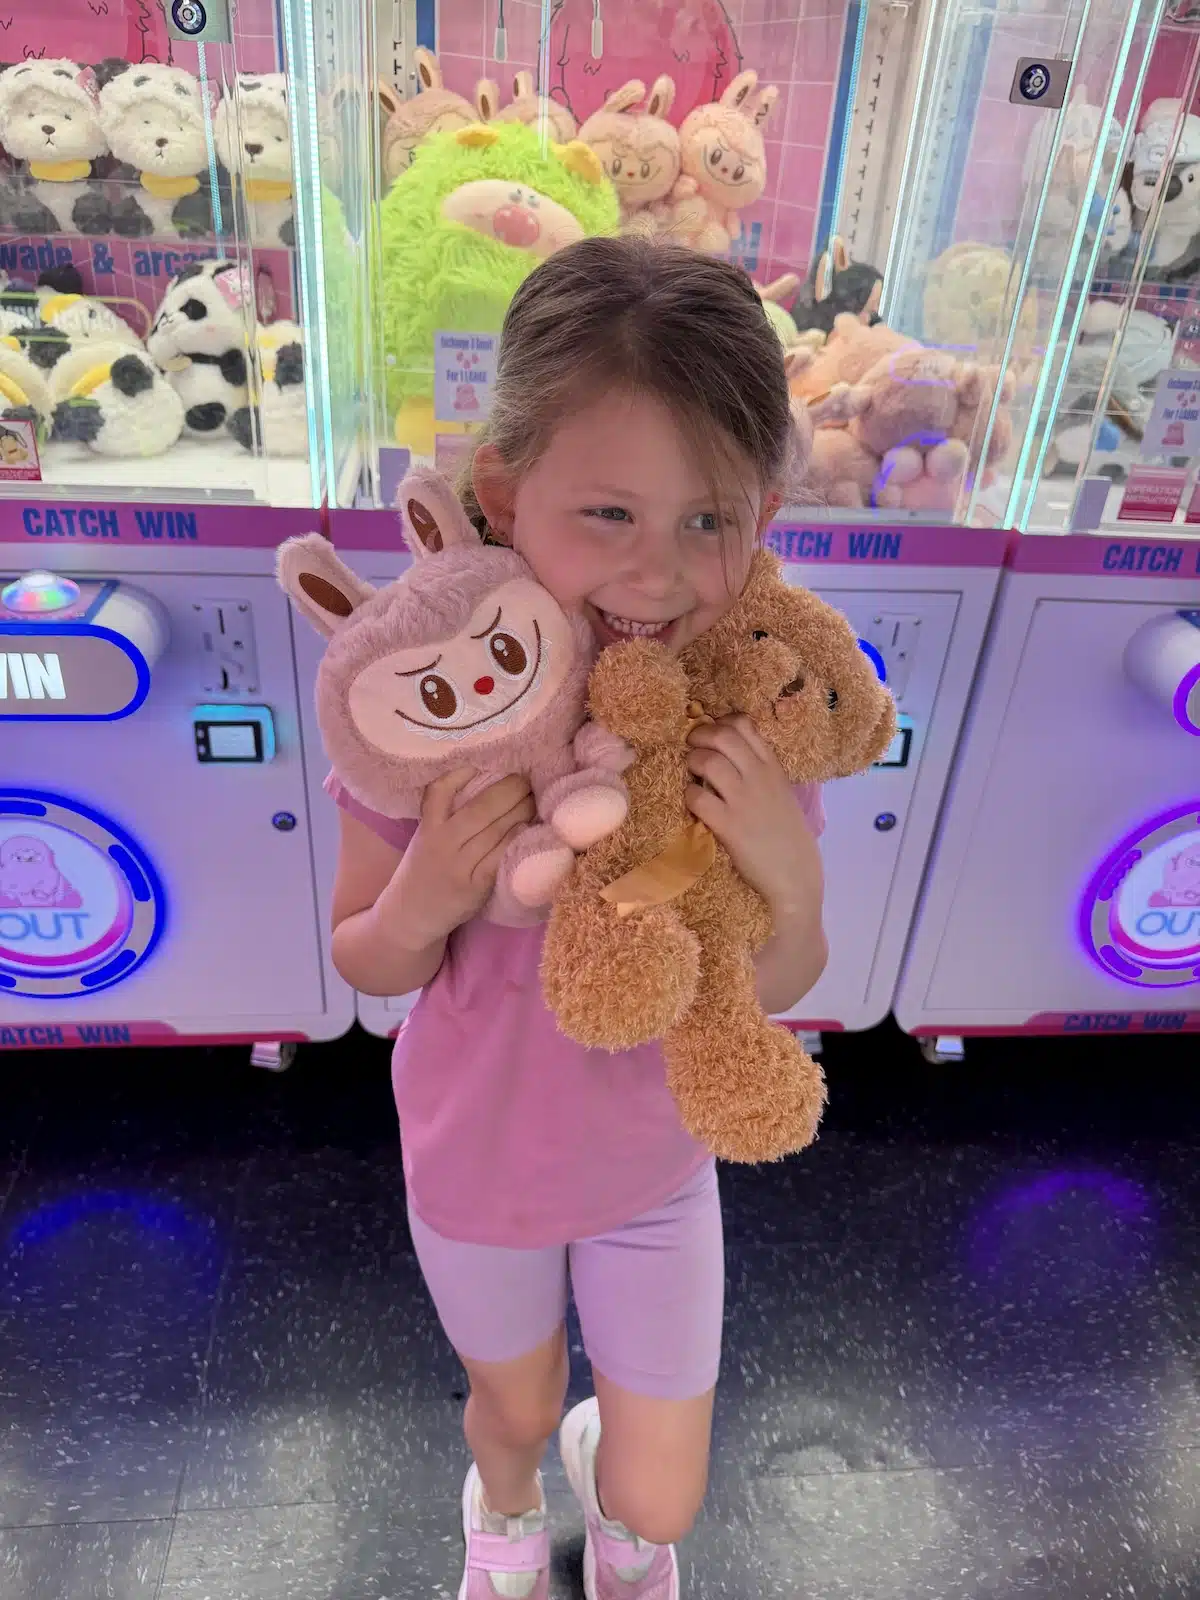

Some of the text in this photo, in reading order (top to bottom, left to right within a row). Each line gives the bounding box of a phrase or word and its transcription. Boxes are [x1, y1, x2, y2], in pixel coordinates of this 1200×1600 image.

[92, 243, 114, 273] &
[22, 508, 197, 540] CATCH WIN
[766, 529, 903, 559] ATCH WIN
[1103, 544, 1184, 573] CATCH
[0, 912, 90, 941] OUT
[76, 1024, 131, 1044] WIN
[1064, 1011, 1186, 1032] CATCH WIN
